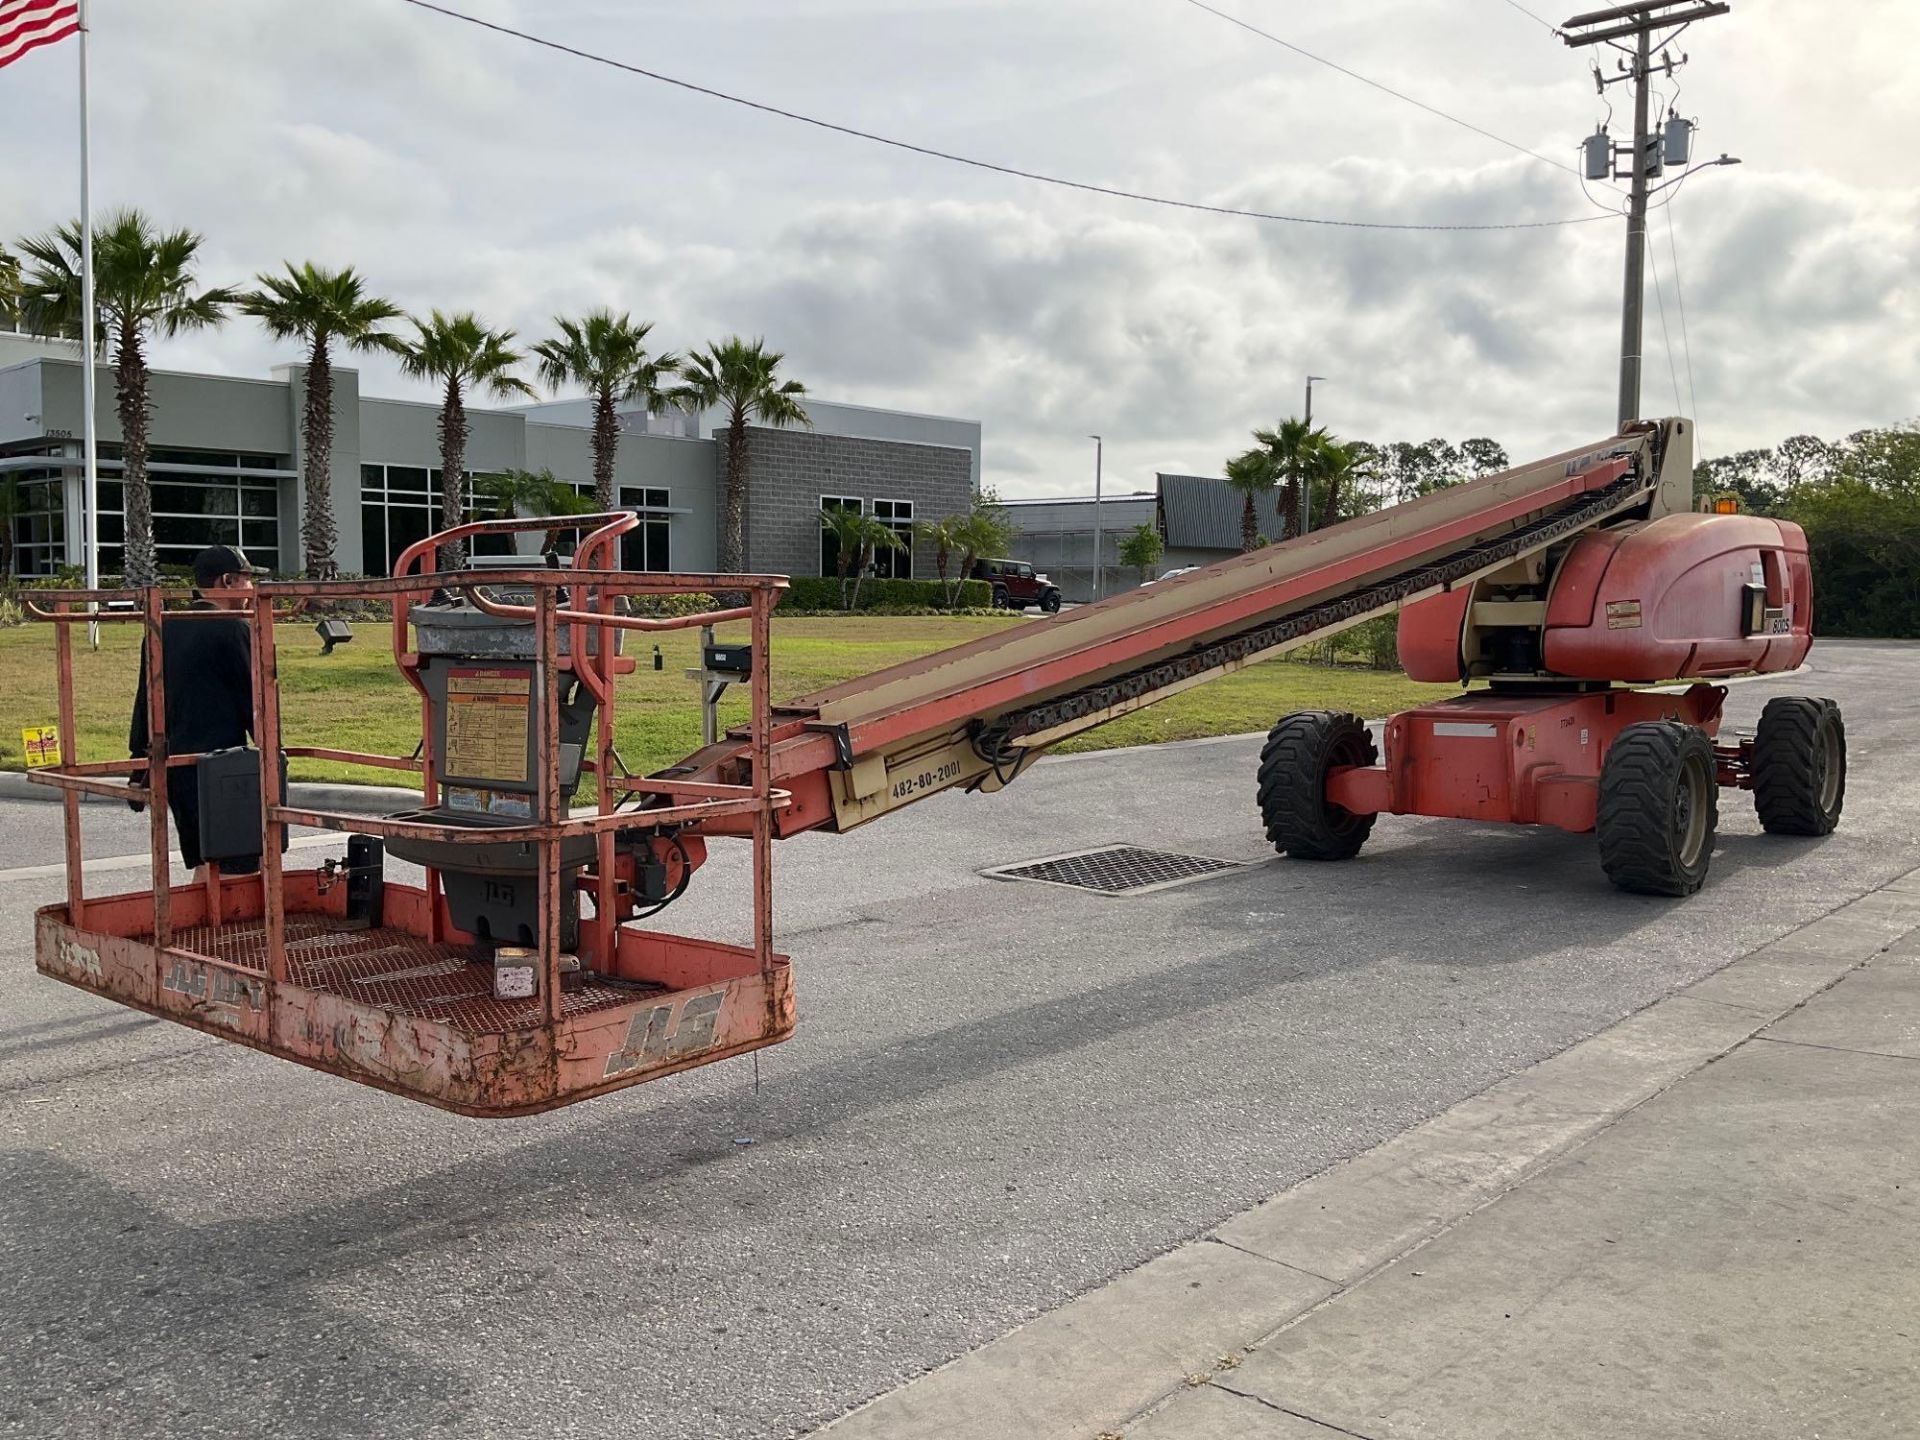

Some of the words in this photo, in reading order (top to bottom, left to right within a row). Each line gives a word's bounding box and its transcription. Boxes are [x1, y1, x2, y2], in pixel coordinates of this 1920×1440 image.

[892, 759, 962, 799] 482-80-2001
[163, 959, 208, 998] JLG
[602, 989, 726, 1079] JLG
